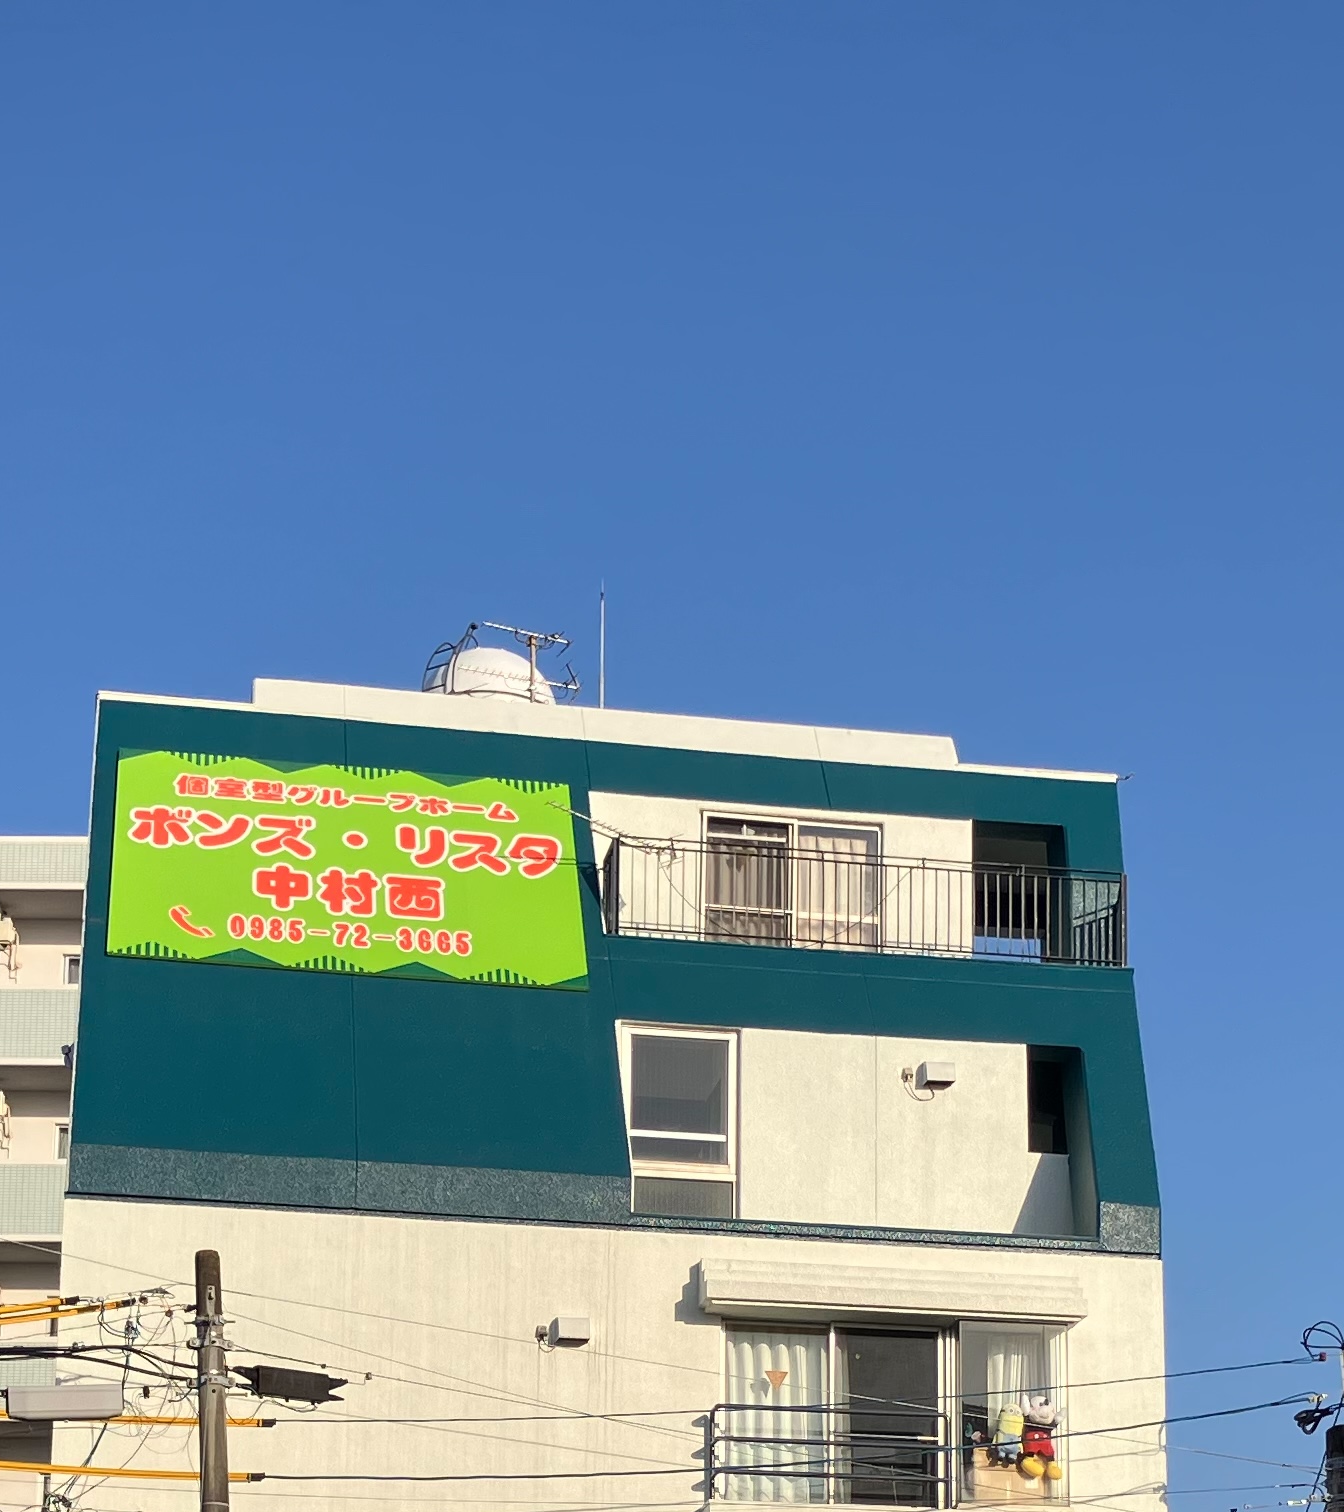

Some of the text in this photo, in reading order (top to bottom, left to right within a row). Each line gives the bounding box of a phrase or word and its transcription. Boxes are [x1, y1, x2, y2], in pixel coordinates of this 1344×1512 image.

[173, 772, 519, 823] 個室型グループホーム
[127, 805, 562, 879] ボンズ・リスタ
[254, 863, 446, 920] 中村西
[227, 913, 472, 957] 0985-72-3665
